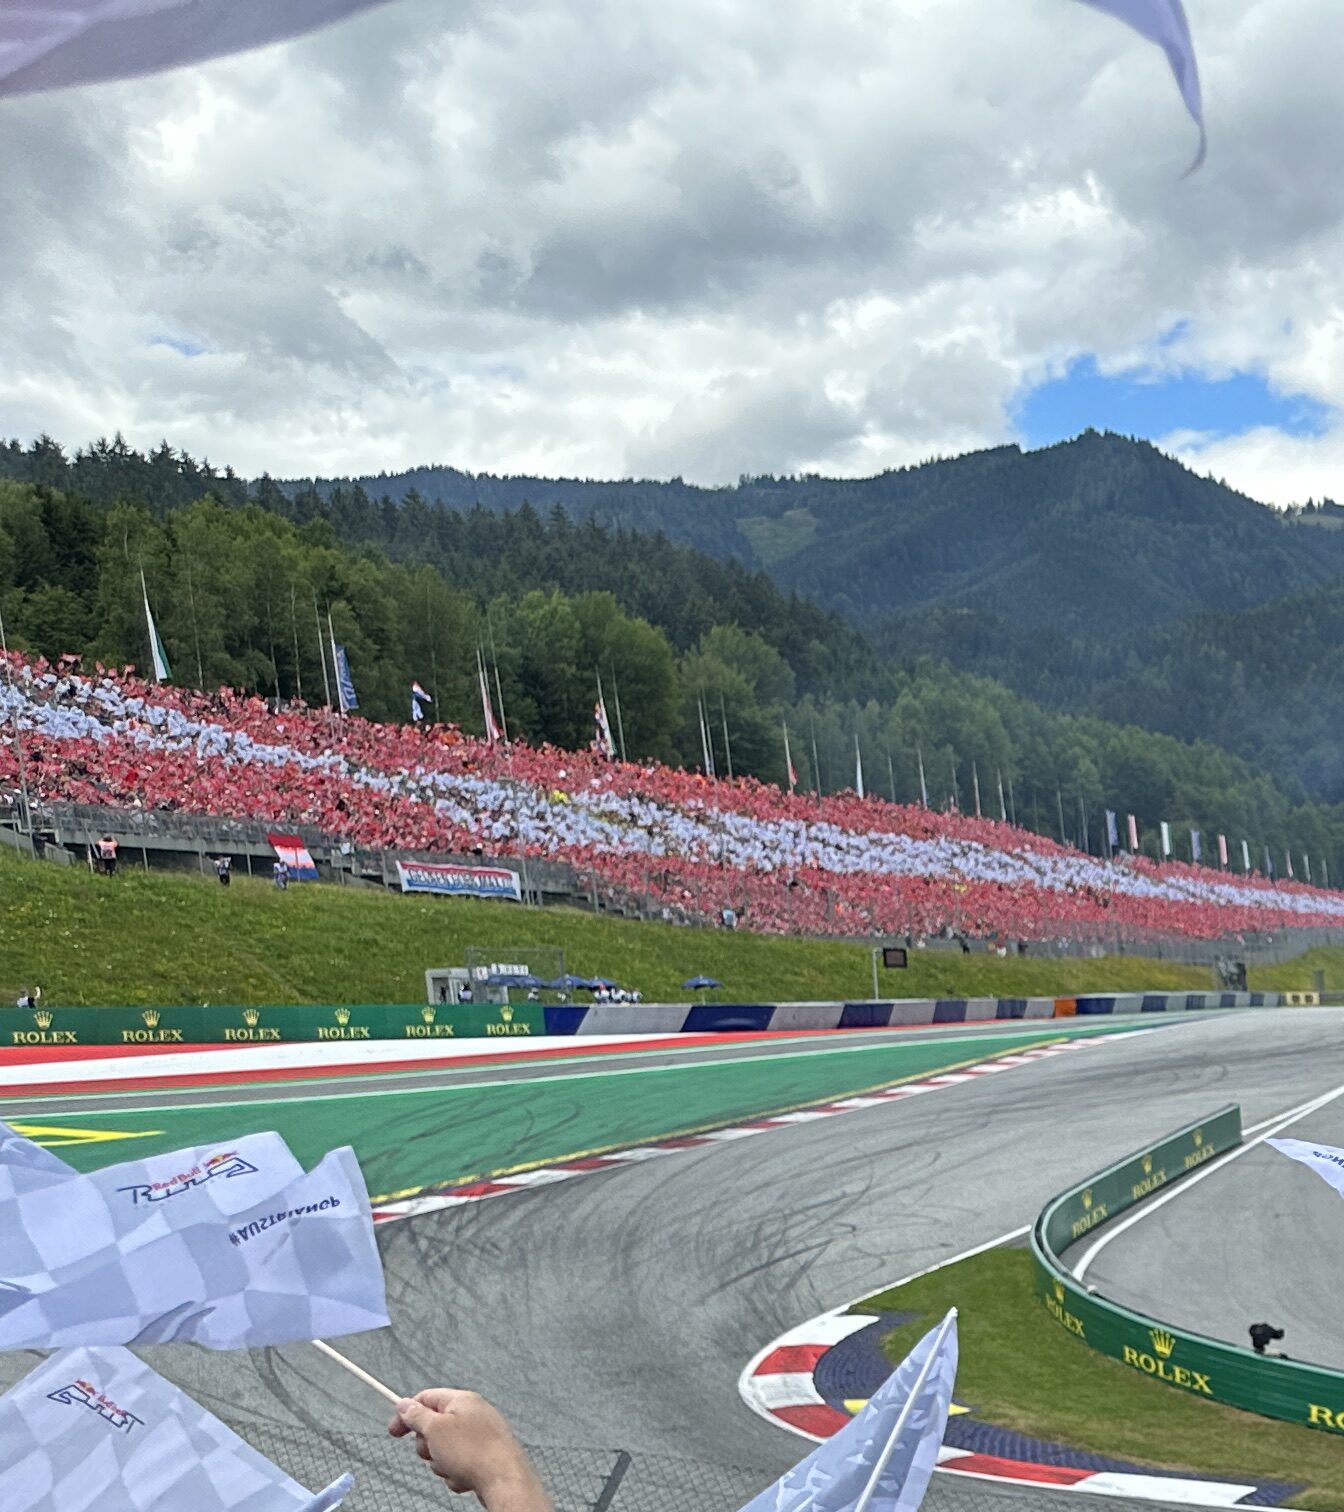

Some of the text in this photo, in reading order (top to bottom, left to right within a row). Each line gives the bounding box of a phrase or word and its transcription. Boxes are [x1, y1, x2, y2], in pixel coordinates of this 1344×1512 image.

[122, 1029, 183, 1042] ROLEX
[225, 1028, 281, 1041] ROLEX
[318, 1026, 370, 1039] ROLEX
[405, 1025, 454, 1038] ROLEX
[487, 1023, 531, 1036] ROLEX
[12, 1031, 77, 1044] ROLEX
[1184, 1144, 1216, 1169] ROLEX
[1131, 1171, 1167, 1199] ROLEX
[1071, 1204, 1108, 1238] ROLEX
[1045, 1293, 1085, 1338] ROLEX
[1123, 1344, 1213, 1395] ROLEX
